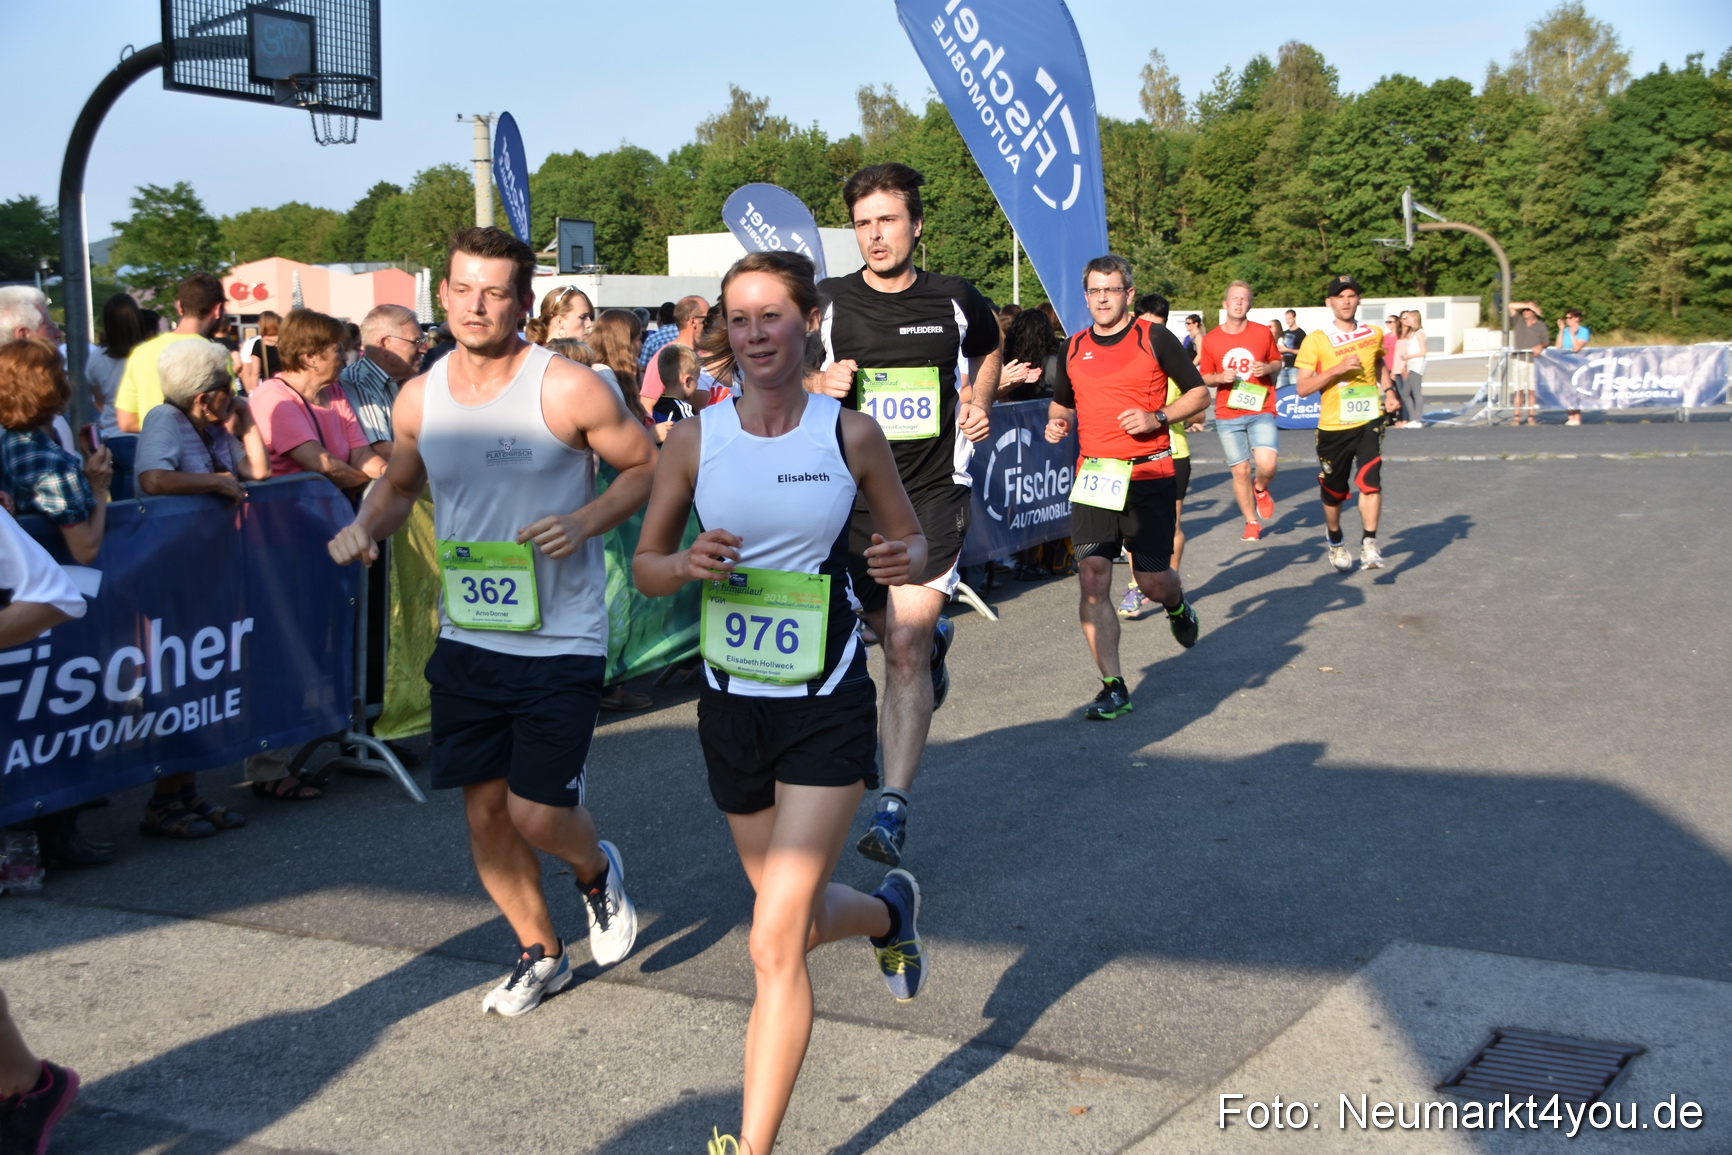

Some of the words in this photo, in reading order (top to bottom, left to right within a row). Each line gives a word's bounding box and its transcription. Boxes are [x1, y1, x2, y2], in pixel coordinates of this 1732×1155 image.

[906, 326, 943, 334] PFLEIDERER
[1335, 345, 1357, 357] MAX
[1227, 357, 1250, 373] 48
[1592, 372, 1687, 390] Fischer
[1236, 392, 1256, 407] 550
[1600, 390, 1678, 400] AUTOMOBILE
[867, 396, 931, 420] 1068
[1347, 401, 1370, 413] 902
[486, 450, 532, 459] PLATZHIRSCH
[777, 472, 830, 483] Elisabeth
[1082, 474, 1122, 496] 1376
[1009, 501, 1072, 530] AUTOMOBILE
[461, 576, 518, 605] 362
[721, 583, 763, 596] firmenlauf
[725, 612, 799, 655] 976
[726, 655, 759, 667] Elisabeth
[760, 660, 795, 670] Hollweck
[4, 687, 242, 775] AUTOMOBILE
